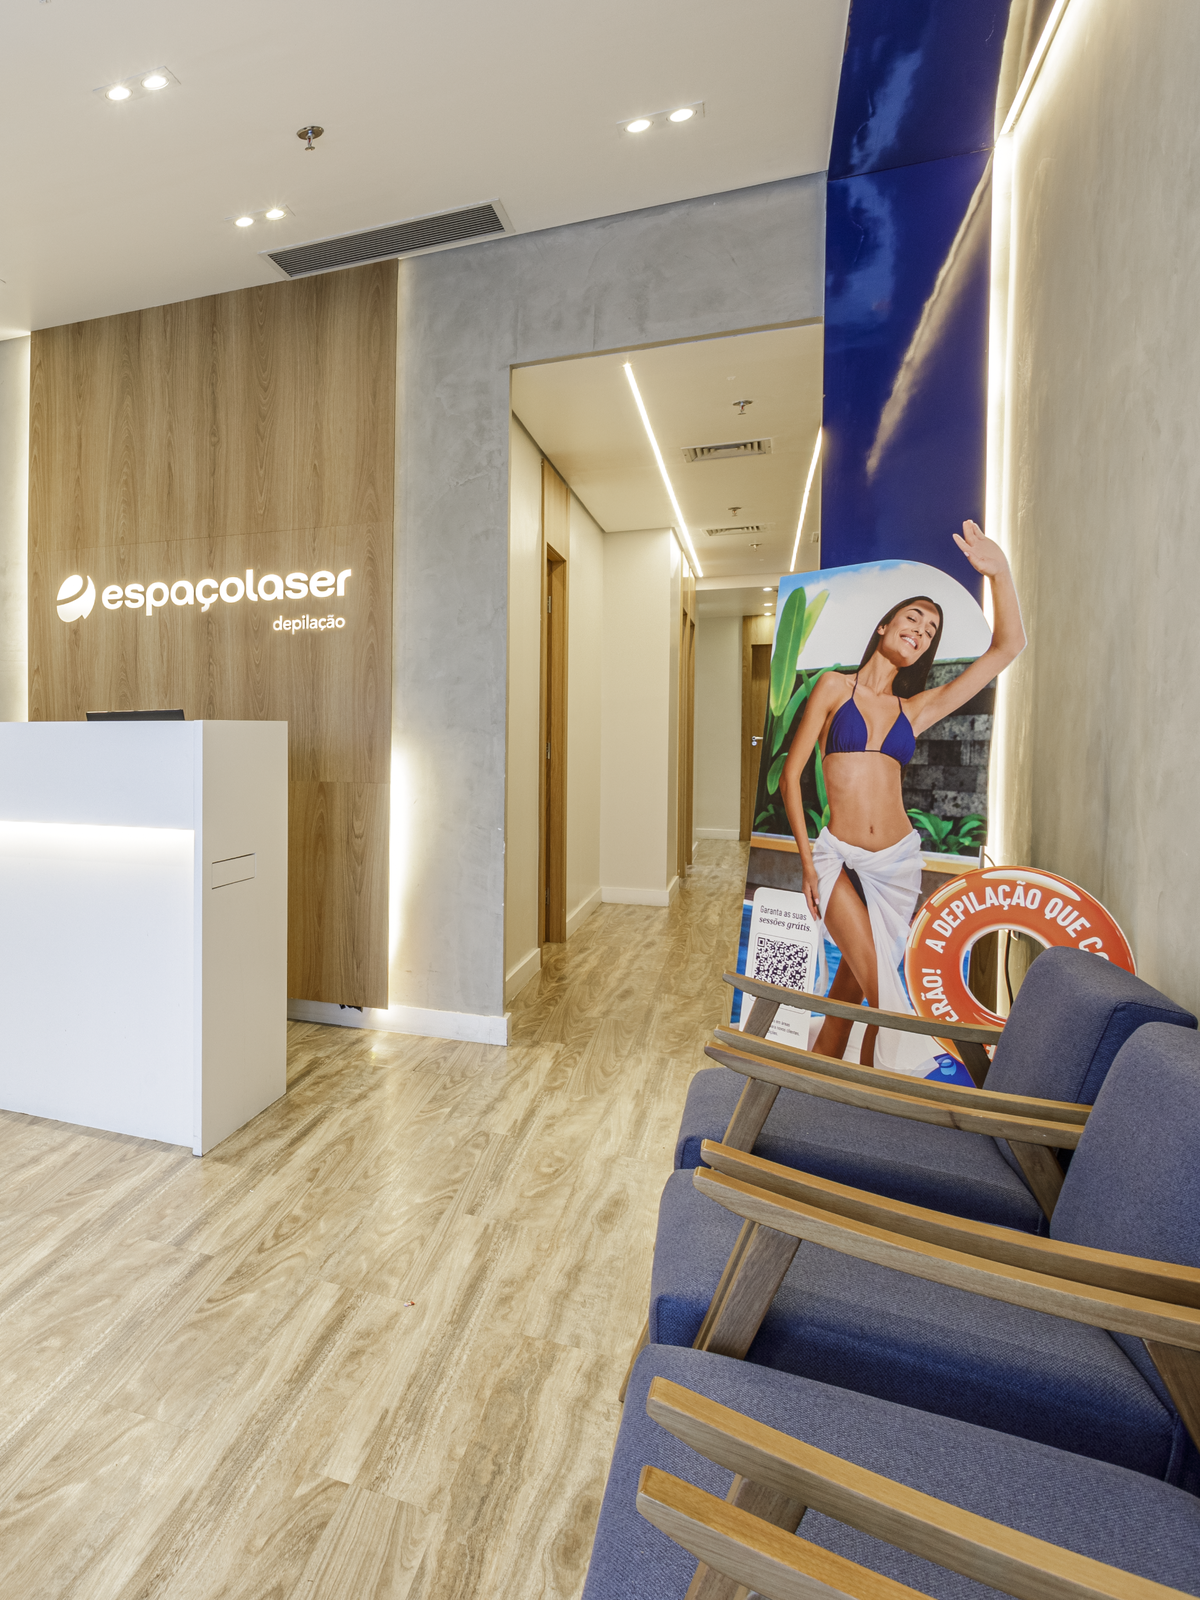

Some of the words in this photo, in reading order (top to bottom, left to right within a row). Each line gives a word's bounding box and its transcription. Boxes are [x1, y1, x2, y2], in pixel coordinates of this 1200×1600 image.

[102, 568, 352, 616] espaçolaser
[272, 614, 346, 635] depilação
[760, 905, 782, 917] Garanta
[792, 912, 807, 921] suas
[932, 880, 1042, 938] DEPILAÇÃO
[1044, 897, 1091, 938] QUE
[759, 917, 785, 927] sessões
[786, 922, 812, 932] grátis.
[925, 937, 946, 954] A
[1078, 936, 1109, 960] C
